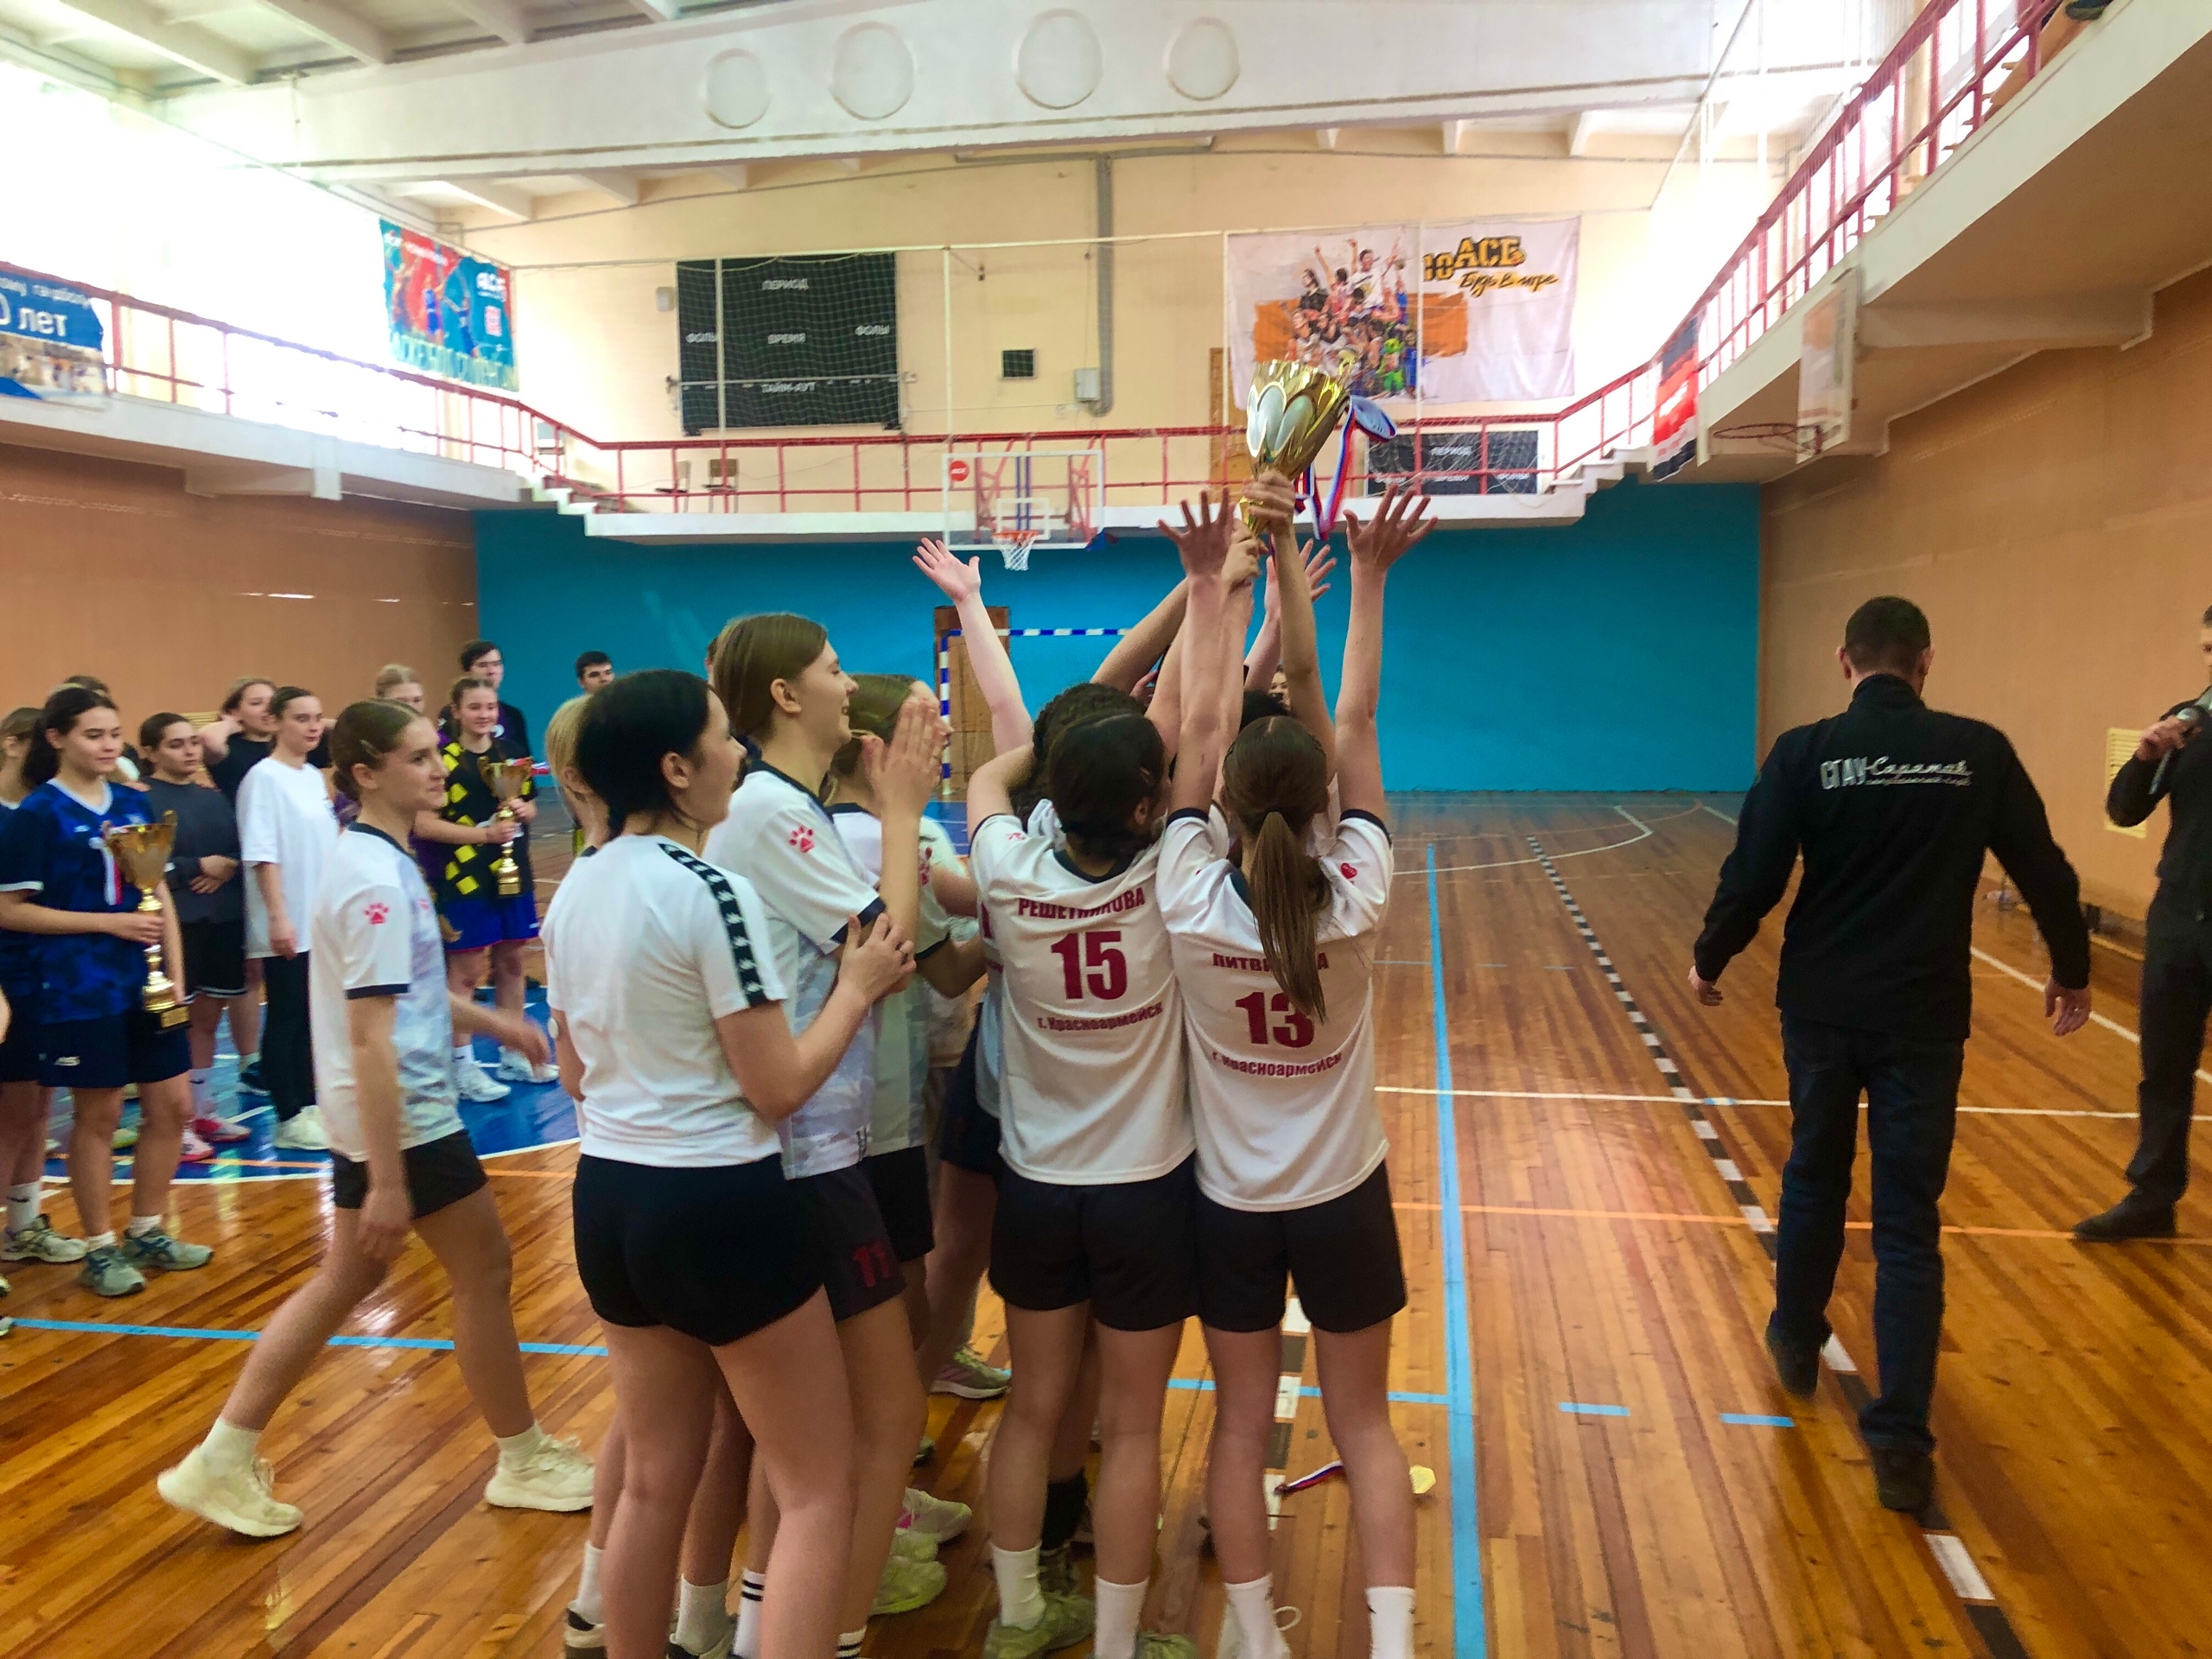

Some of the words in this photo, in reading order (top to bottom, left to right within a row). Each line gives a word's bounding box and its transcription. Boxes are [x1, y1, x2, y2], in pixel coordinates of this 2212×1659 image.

[17, 307, 67, 337] лет
[1050, 931, 1128, 1000] 15
[1235, 992, 1315, 1048] 13
